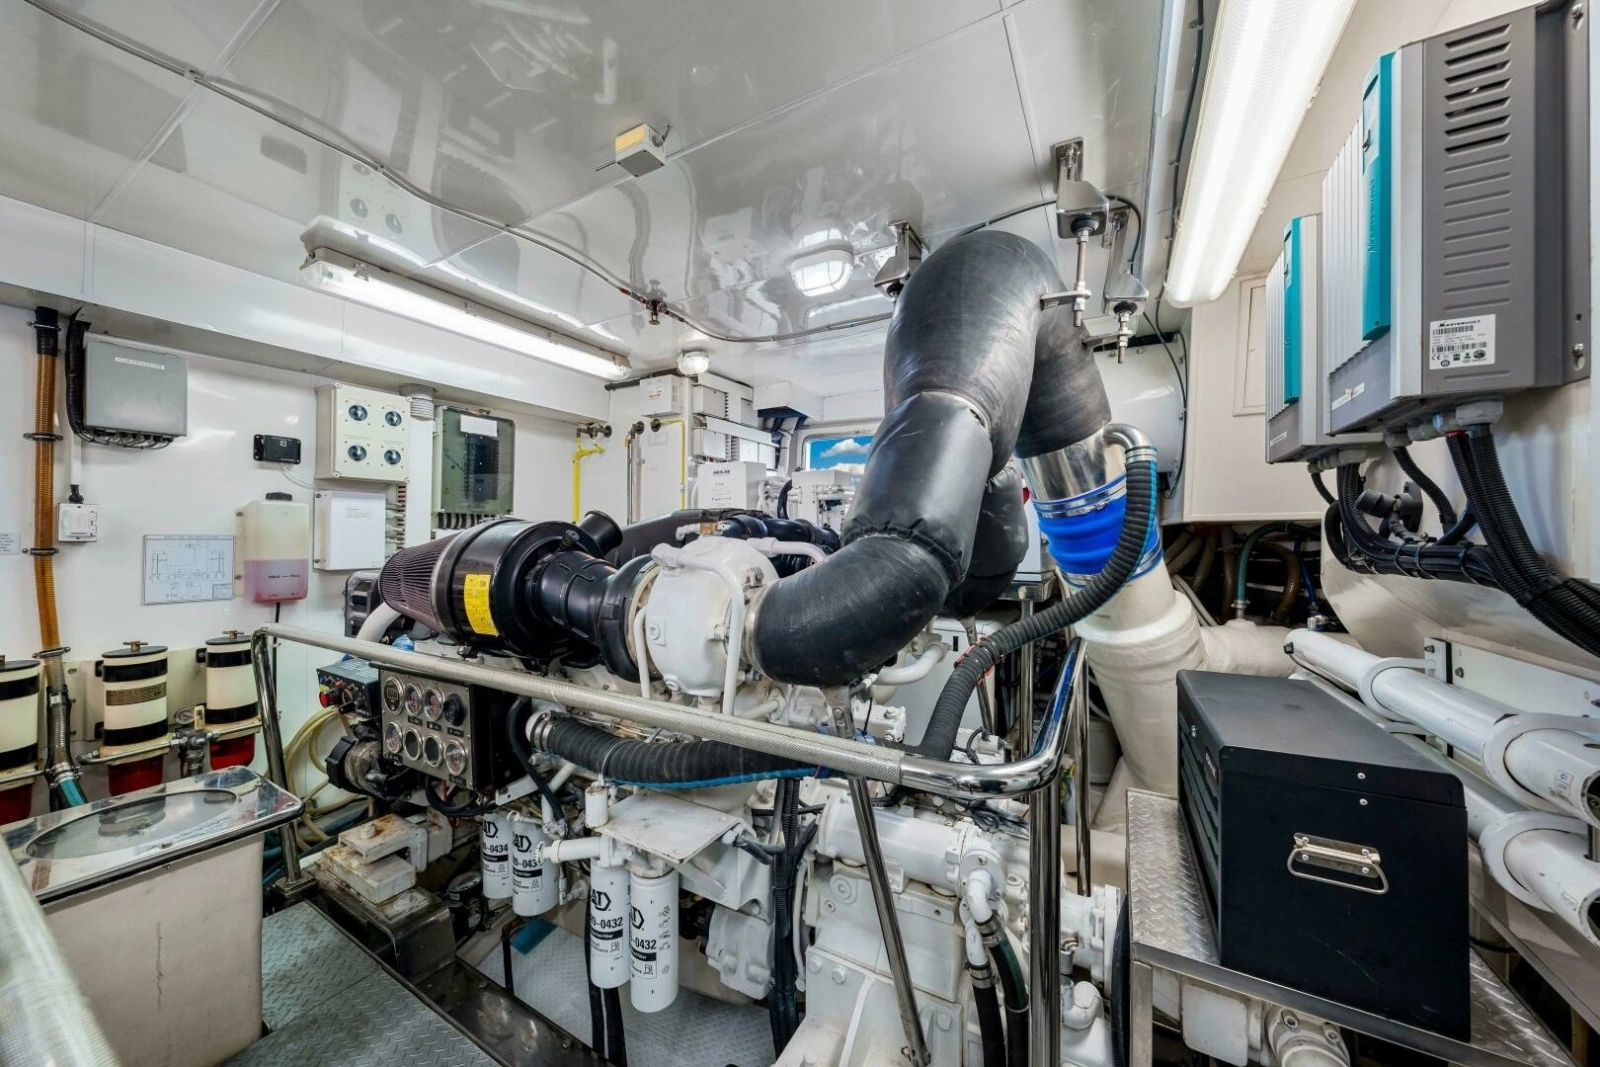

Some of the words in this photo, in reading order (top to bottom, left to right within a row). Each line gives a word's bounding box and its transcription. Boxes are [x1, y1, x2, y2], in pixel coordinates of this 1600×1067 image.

[1438, 319, 1481, 328] MASTERVOLT
[483, 843, 509, 854] -0434
[631, 937, 657, 951] -0432
